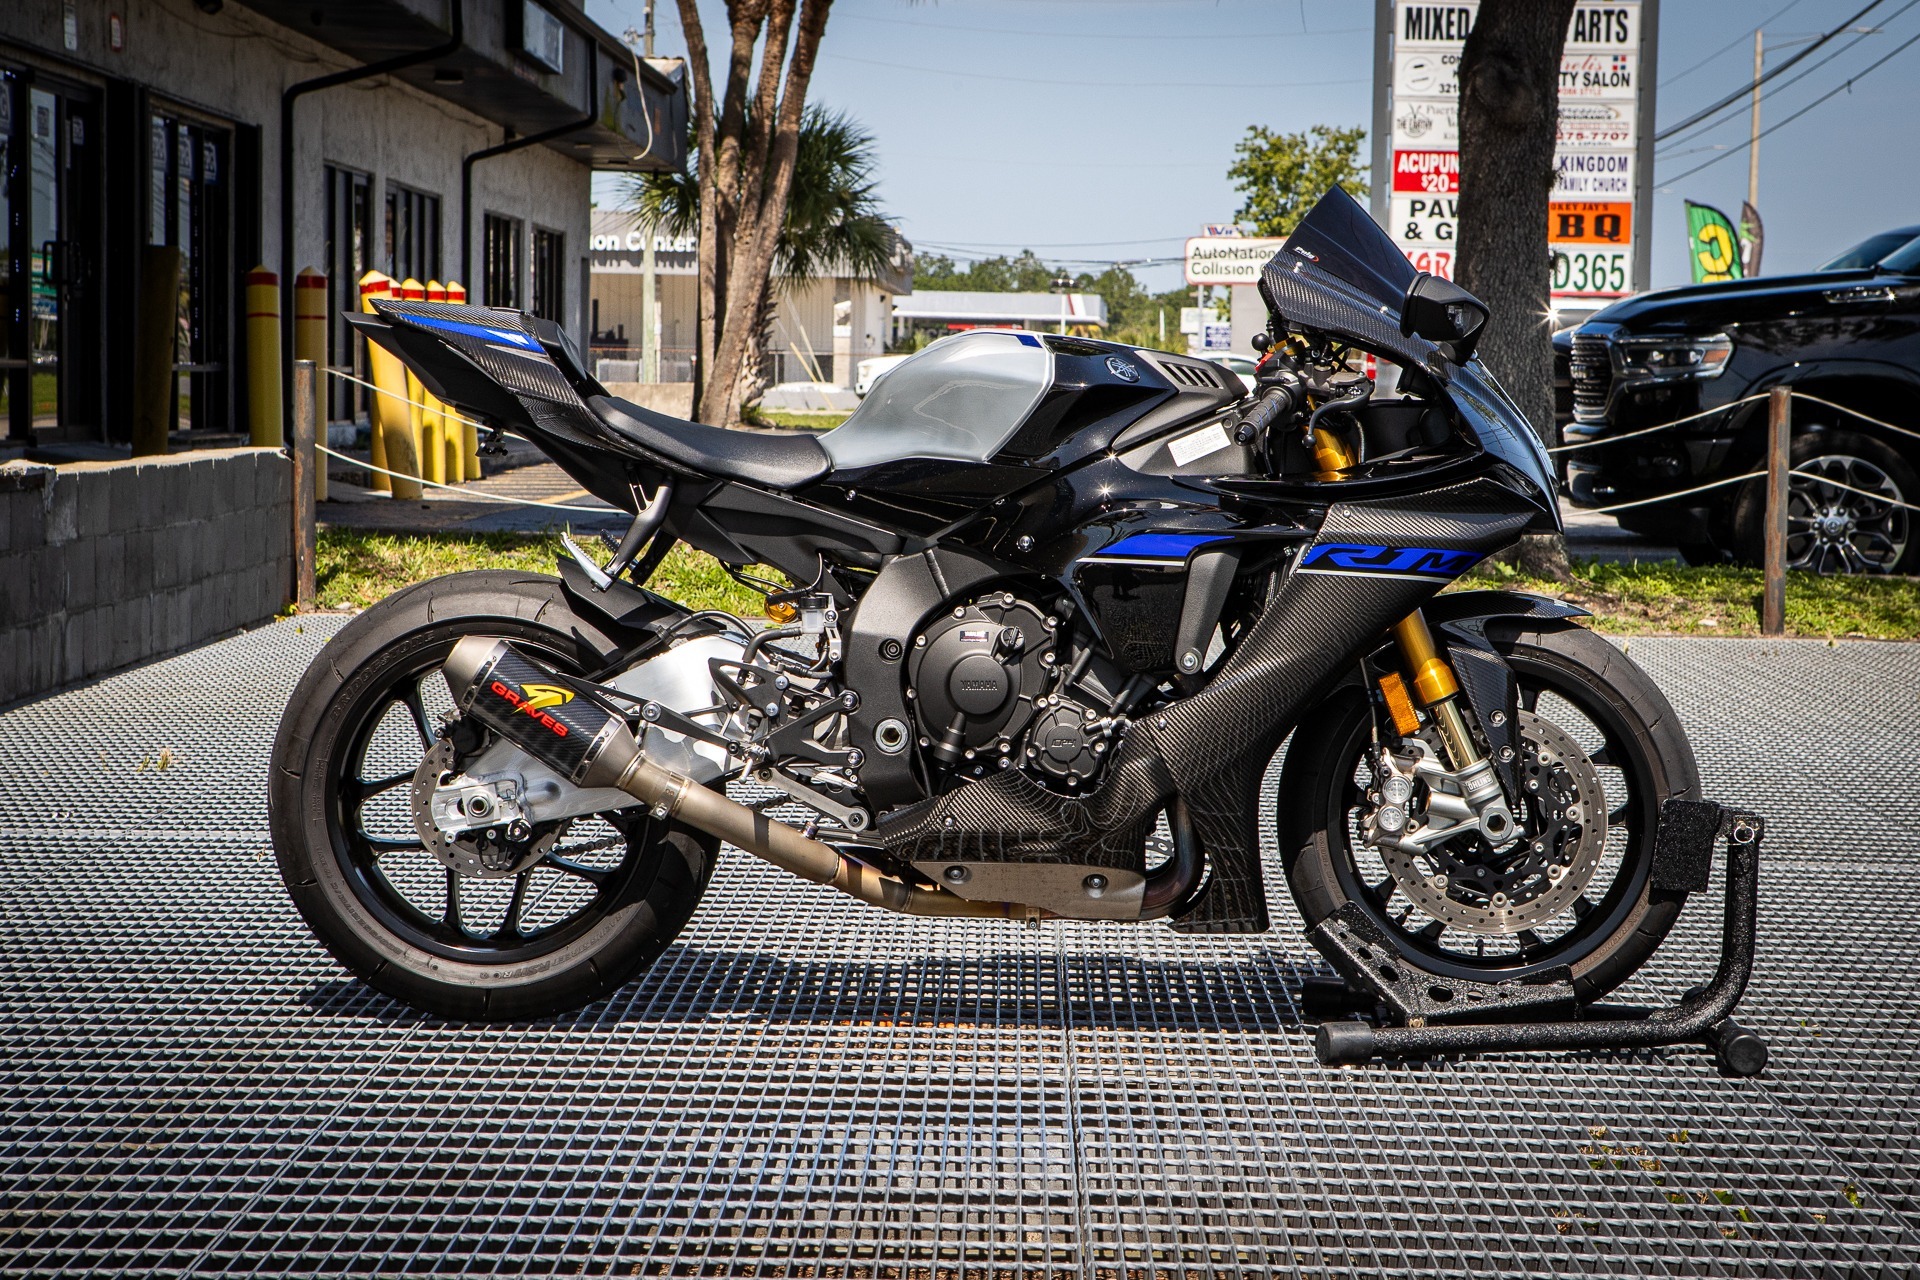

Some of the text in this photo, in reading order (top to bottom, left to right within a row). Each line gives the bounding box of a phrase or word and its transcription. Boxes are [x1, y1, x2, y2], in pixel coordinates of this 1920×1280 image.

[1405, 6, 1628, 43] MIXED ARTS
[1583, 72, 1630, 87] SALON
[1560, 156, 1628, 172] KINGDOM
[1592, 177, 1628, 192] CHURCH
[1404, 222, 1423, 240] &
[1192, 247, 1276, 259] AutoNation
[1191, 262, 1254, 275] Collision
[961, 680, 997, 690] YAMAHA
[490, 680, 570, 738] GRAVES
